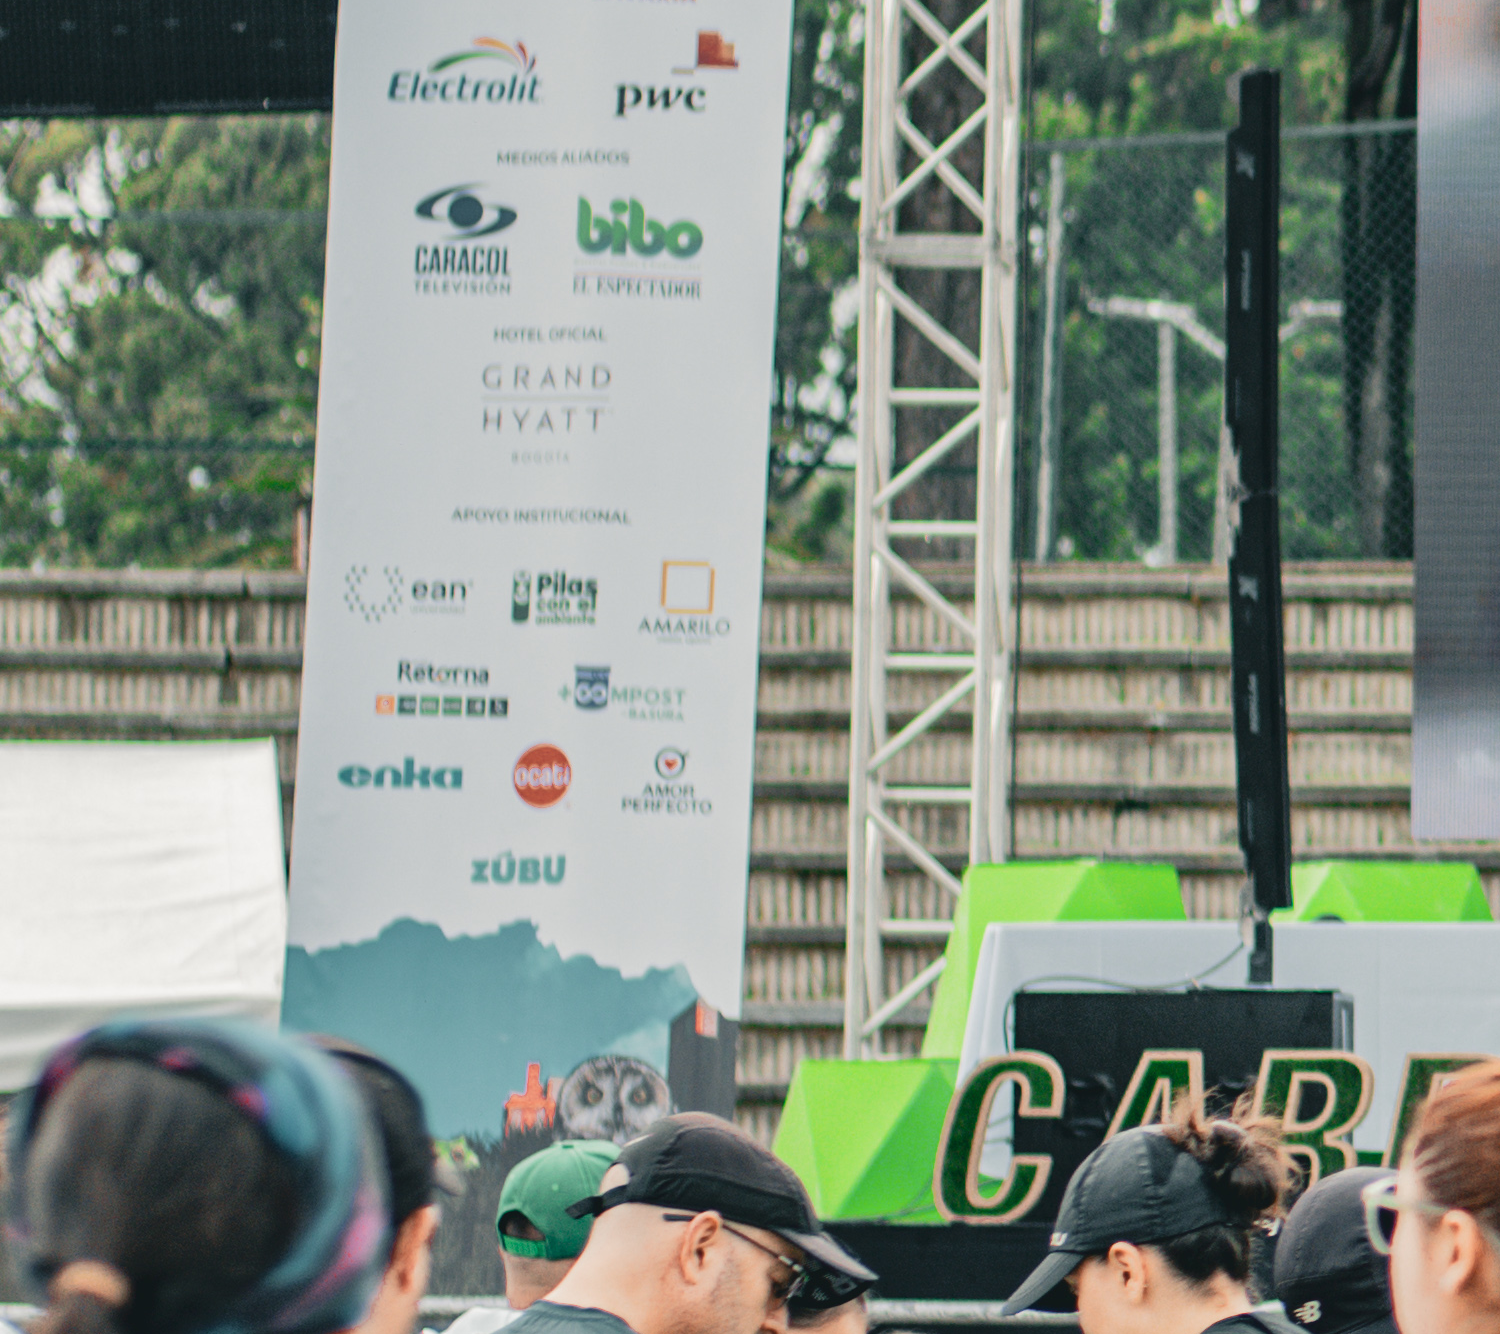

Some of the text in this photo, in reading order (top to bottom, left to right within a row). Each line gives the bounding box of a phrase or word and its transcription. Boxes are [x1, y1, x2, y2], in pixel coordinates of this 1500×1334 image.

[387, 71, 542, 104] Electrolit
[613, 81, 707, 118] pwc
[496, 150, 631, 166] MEDIOS ALIADOS
[576, 195, 704, 259] bibo
[415, 244, 511, 276] CARACOL
[494, 327, 607, 342] HOTEL OFICIAL
[481, 363, 612, 391] GRAND
[482, 406, 606, 434] HYATT
[451, 508, 632, 526] APOYO INSTITUCIONAL
[411, 576, 467, 601] ean
[536, 571, 599, 598] Pilas
[536, 597, 570, 613] con
[638, 617, 731, 636] AMARILO
[397, 660, 490, 686] Retorna
[338, 756, 463, 790] enka
[642, 783, 694, 798] AMOR
[621, 798, 712, 815] PERFECTO
